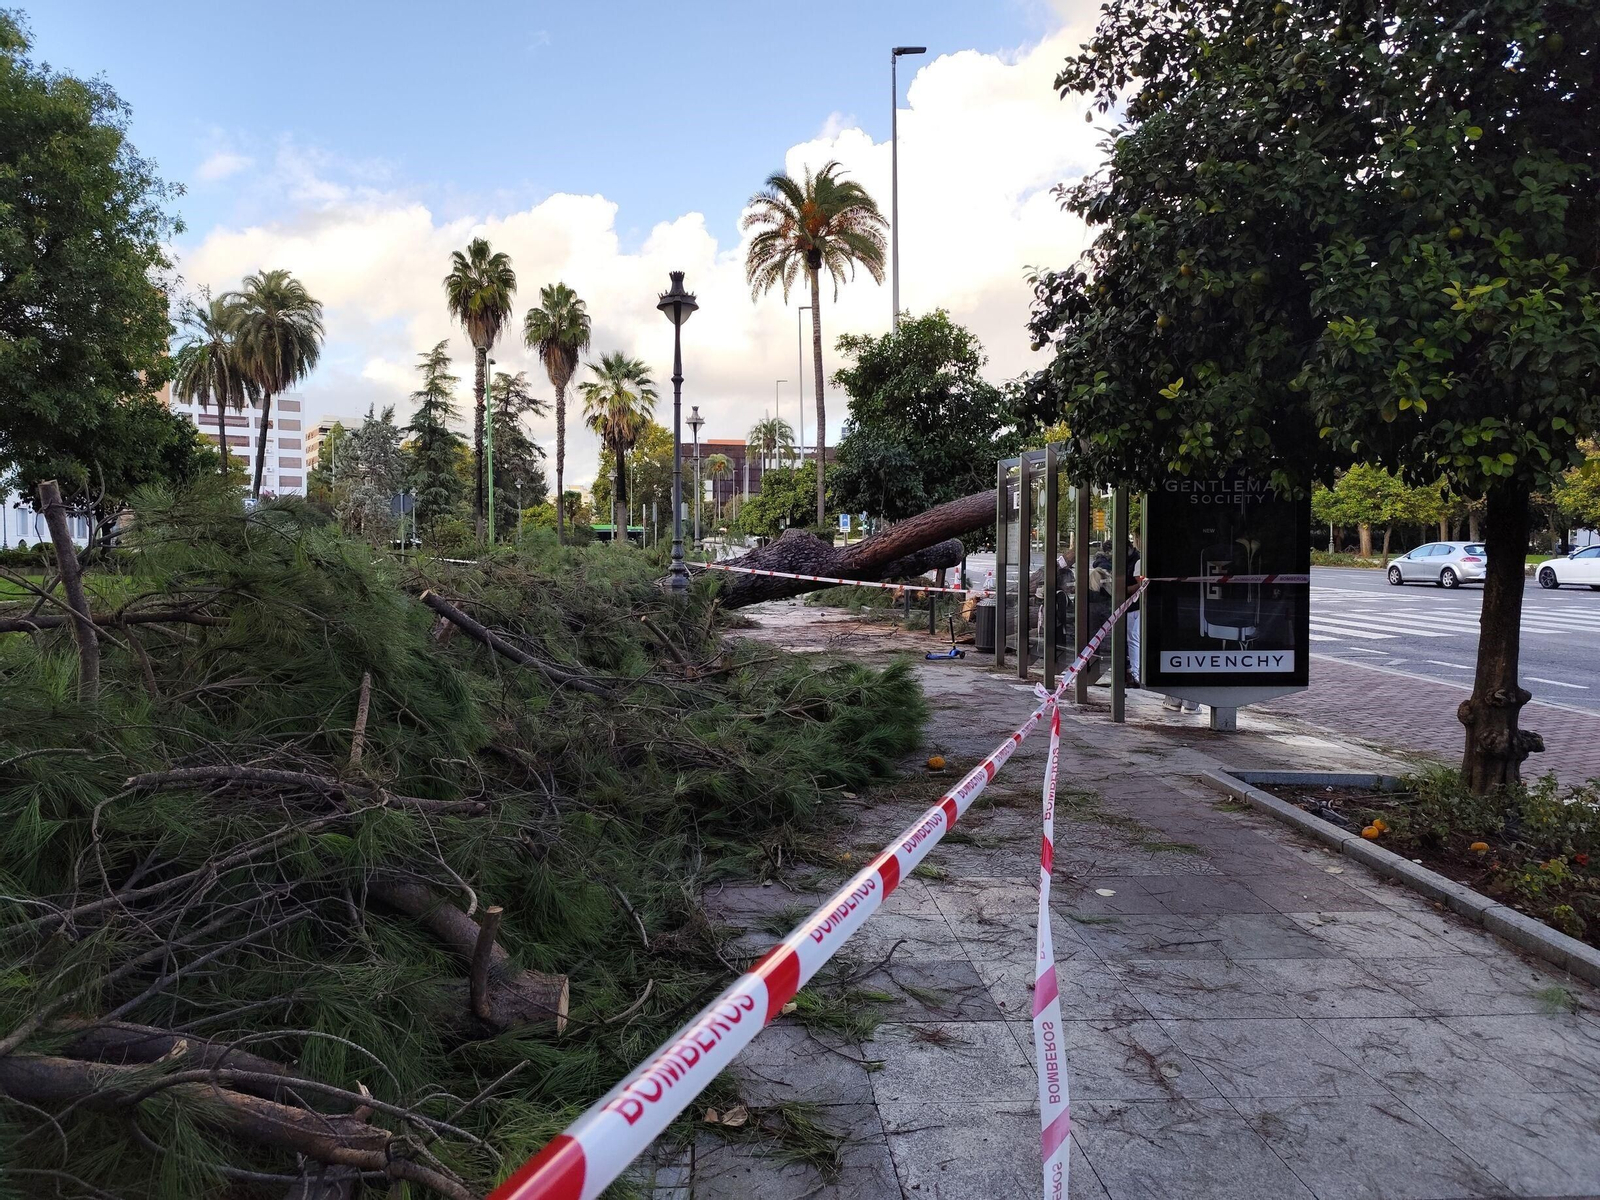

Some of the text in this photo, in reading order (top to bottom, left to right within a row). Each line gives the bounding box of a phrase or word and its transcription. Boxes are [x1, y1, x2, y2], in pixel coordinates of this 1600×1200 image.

[1165, 480, 1282, 492] GENTLEMA
[1190, 494, 1265, 504] SOCIETY
[1169, 655, 1284, 668] GIVENCHY
[600, 991, 756, 1126] BOMBEROS
